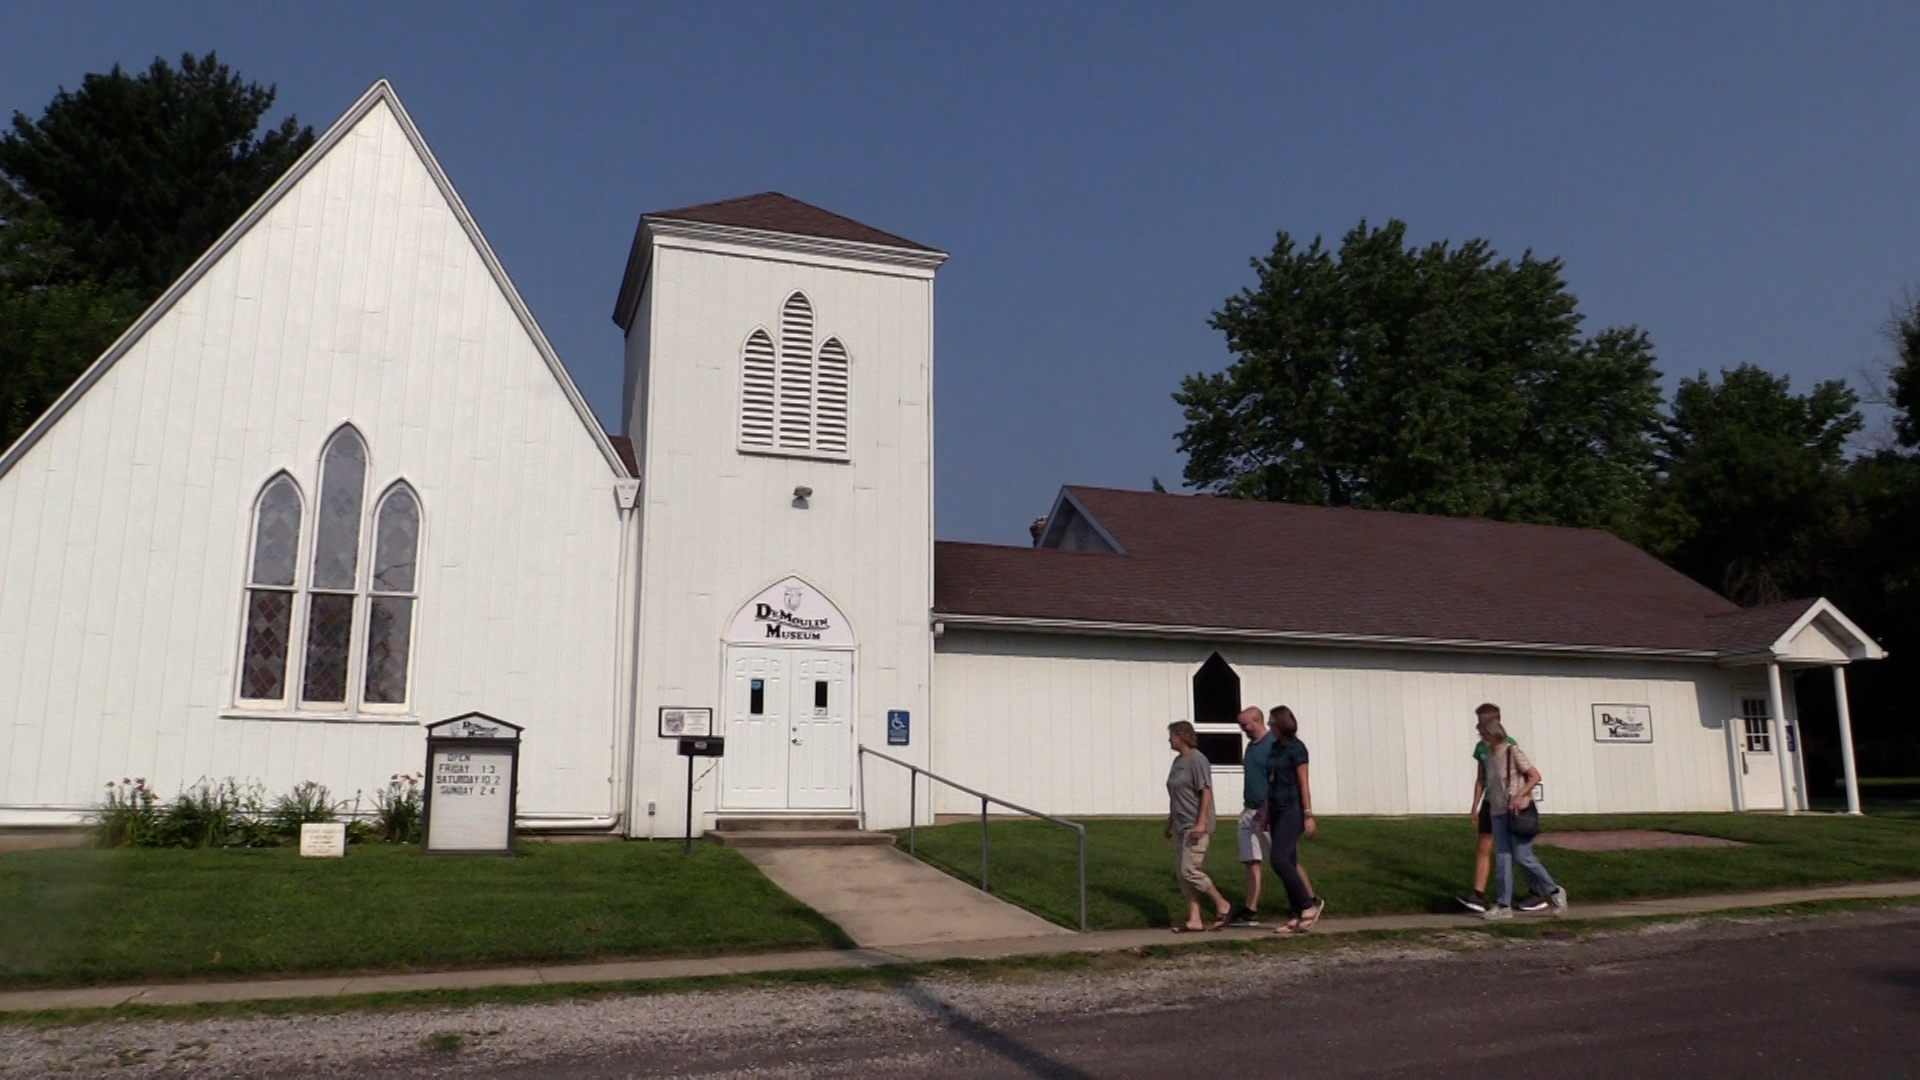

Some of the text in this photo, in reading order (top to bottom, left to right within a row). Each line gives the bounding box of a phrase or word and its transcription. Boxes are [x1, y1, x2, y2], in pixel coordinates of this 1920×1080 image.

[765, 623, 821, 640] MUSEUM
[447, 752, 471, 762] OPEN
[439, 763, 470, 774] FRIDAY
[435, 775, 480, 784] SATURDAY
[440, 785, 474, 796] SUNDAY
